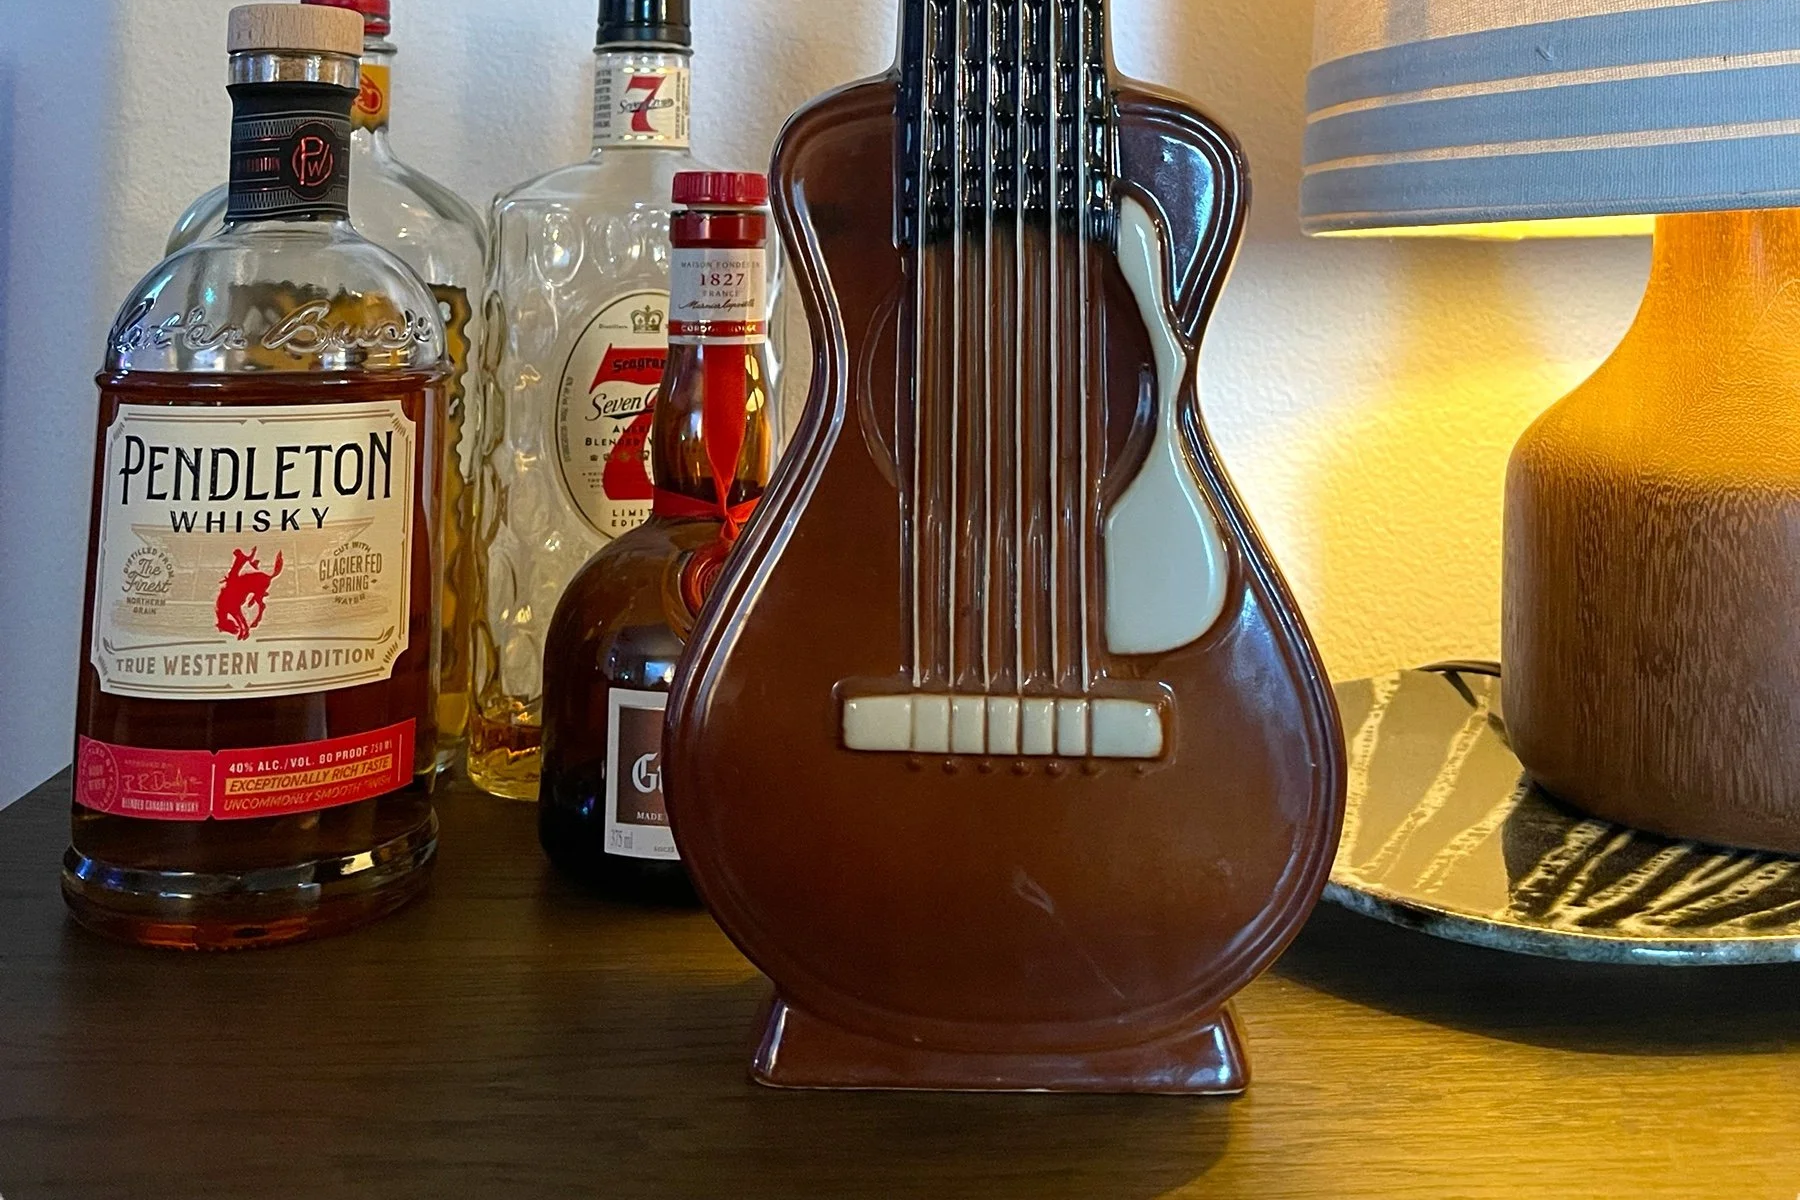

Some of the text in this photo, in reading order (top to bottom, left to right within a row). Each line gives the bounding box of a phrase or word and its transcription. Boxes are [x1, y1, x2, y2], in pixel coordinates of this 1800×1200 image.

[624, 75, 668, 133] 7
[699, 273, 745, 286] 1827
[584, 393, 642, 421] Seven
[119, 431, 393, 505] PENDLETON
[170, 506, 330, 533] WHISKY
[611, 519, 645, 527] EDIT
[612, 508, 653, 517] LIMIT
[333, 541, 372, 557] CUT WITH
[123, 547, 175, 578] DISTILLED FROM
[138, 558, 162, 576] The
[319, 552, 382, 581] GLACIER FED
[122, 571, 173, 593] Finest
[332, 574, 369, 594] SPRING
[126, 597, 166, 606] NORTHERN
[133, 606, 157, 615] GRAIN
[115, 648, 376, 676] TRUE WESTERN TRADITION
[228, 761, 254, 774] 40%
[335, 746, 368, 762] PROOF
[229, 756, 390, 793] EXCEPTIONALLY RICH TASTE
[223, 793, 313, 811] UNCOMMONLY
[314, 784, 360, 801] SMOOTH
[636, 811, 663, 821] MADE
